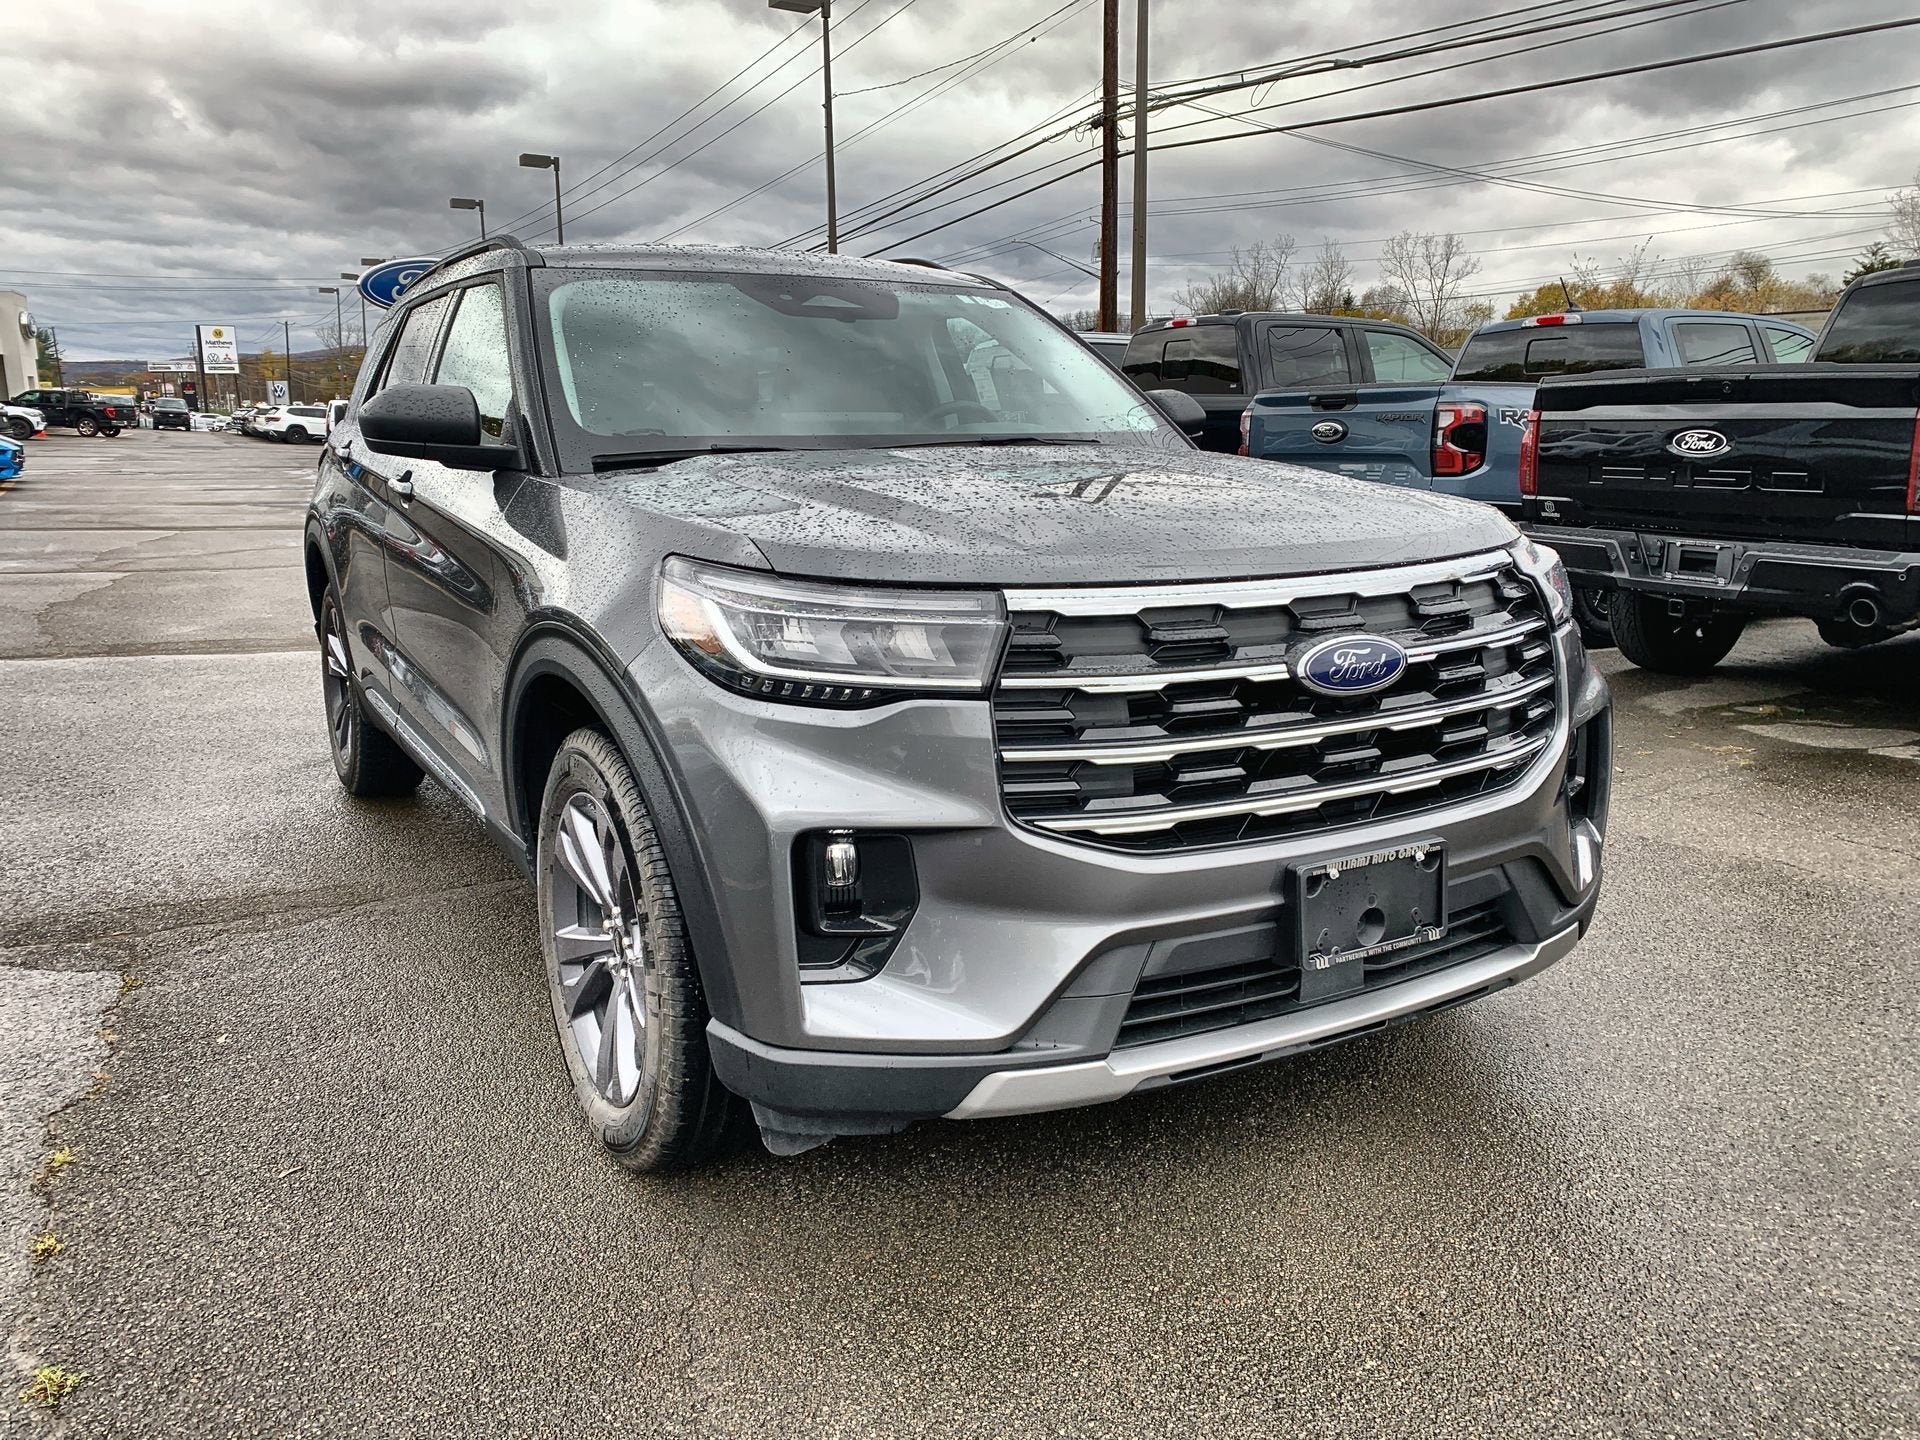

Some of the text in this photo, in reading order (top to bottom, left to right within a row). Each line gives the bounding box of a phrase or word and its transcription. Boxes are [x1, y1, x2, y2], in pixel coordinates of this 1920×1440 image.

[1375, 413, 1426, 425] RAPTOR
[1680, 432, 1716, 451] Ford
[1589, 465, 1824, 493] F-150
[1329, 648, 1387, 683] Ford
[1372, 851, 1396, 865] AUTO
[1335, 937, 1422, 963] PARTNERING WITH THE COMMUNITY
